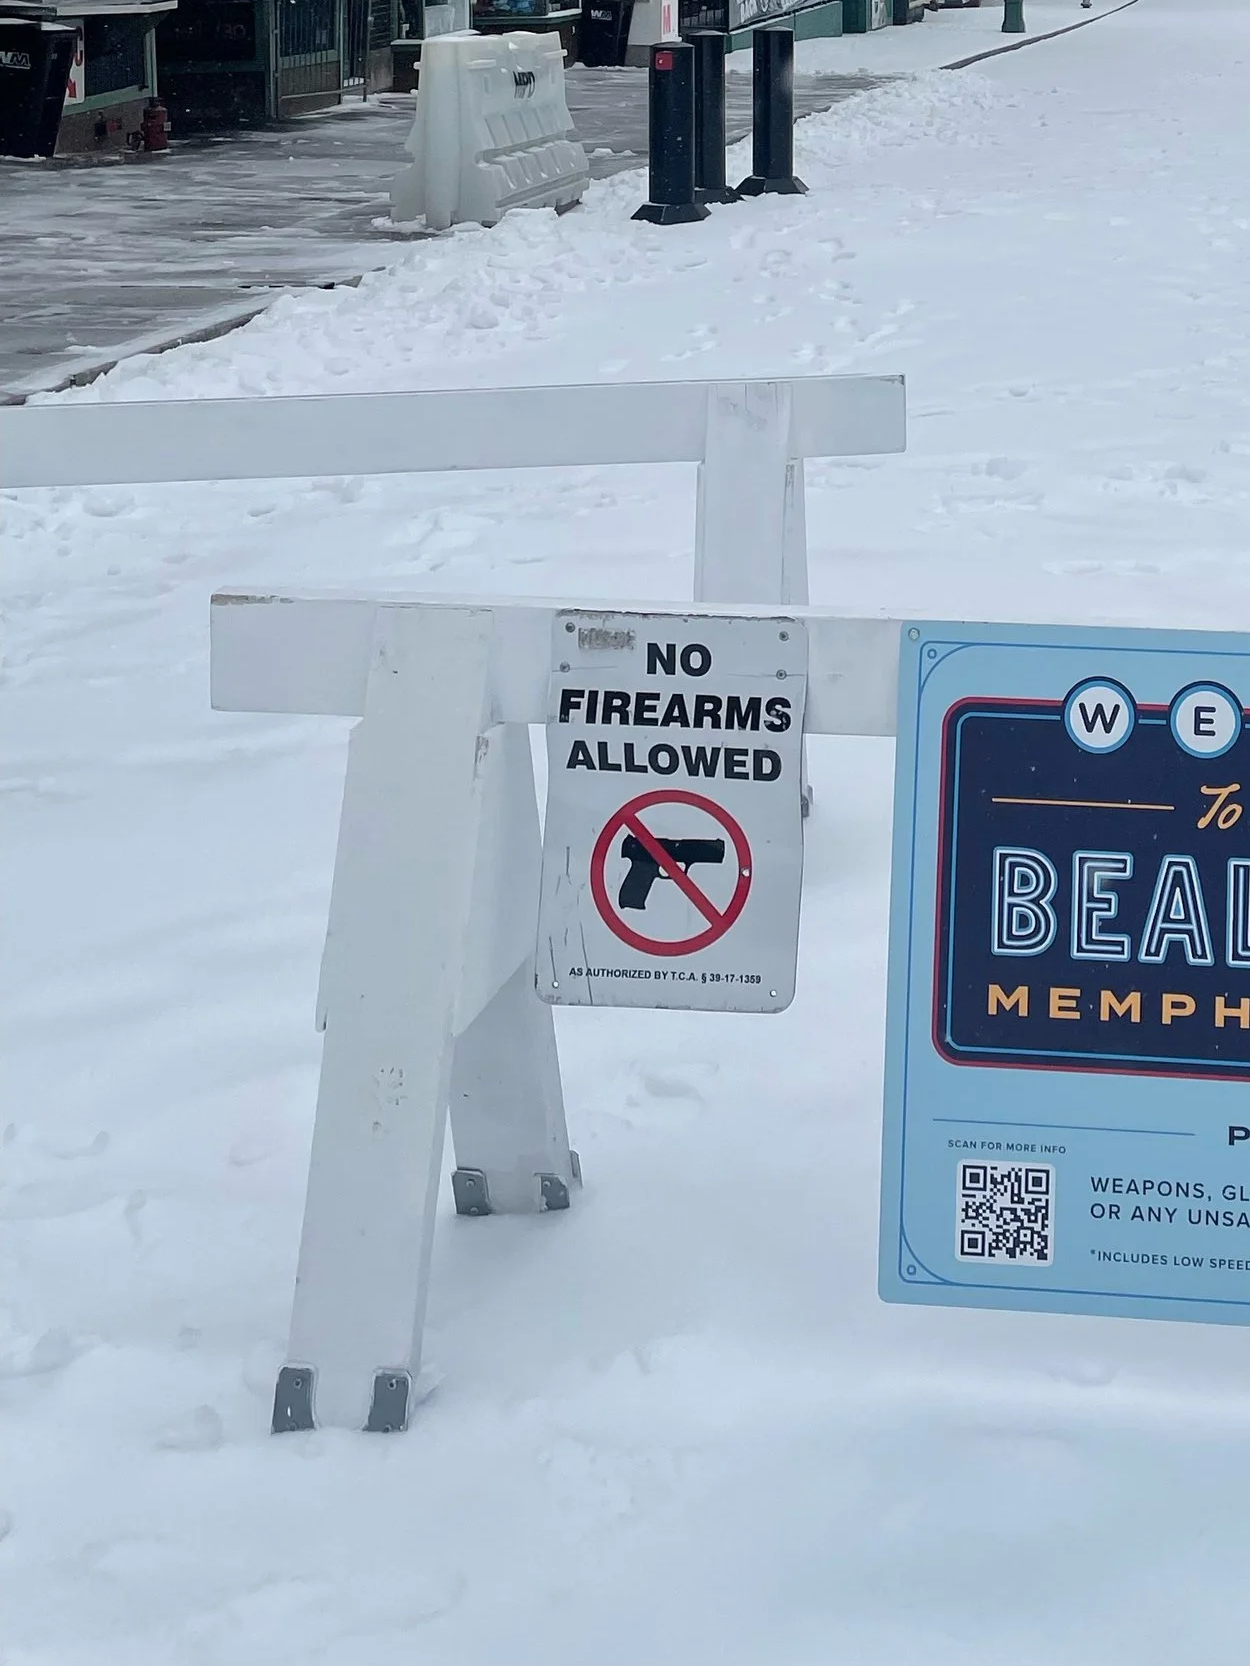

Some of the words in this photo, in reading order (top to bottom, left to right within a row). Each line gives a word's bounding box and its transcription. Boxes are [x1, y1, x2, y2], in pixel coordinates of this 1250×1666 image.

[647, 643, 712, 677] NO
[559, 689, 792, 732] FIREARMS
[566, 740, 782, 782] ALLOWED
[1197, 783, 1243, 830] To
[569, 968, 583, 976] AS
[586, 968, 651, 980] AUTHORIZED
[654, 971, 668, 980] BY
[671, 972, 698, 982] T.C.A.
[701, 972, 707, 984] §
[709, 973, 761, 984] 39-17-1359
[948, 1140, 976, 1149] SCAN
[981, 1141, 1002, 1150] FOR
[1006, 1143, 1036, 1152] MORE
[1041, 1145, 1066, 1154] INFO
[1091, 1176, 1211, 1202] WEAPONS,
[1091, 1203, 1120, 1220] OR
[1131, 1206, 1177, 1223] ANY
[1174, 1256, 1204, 1267] LOW
